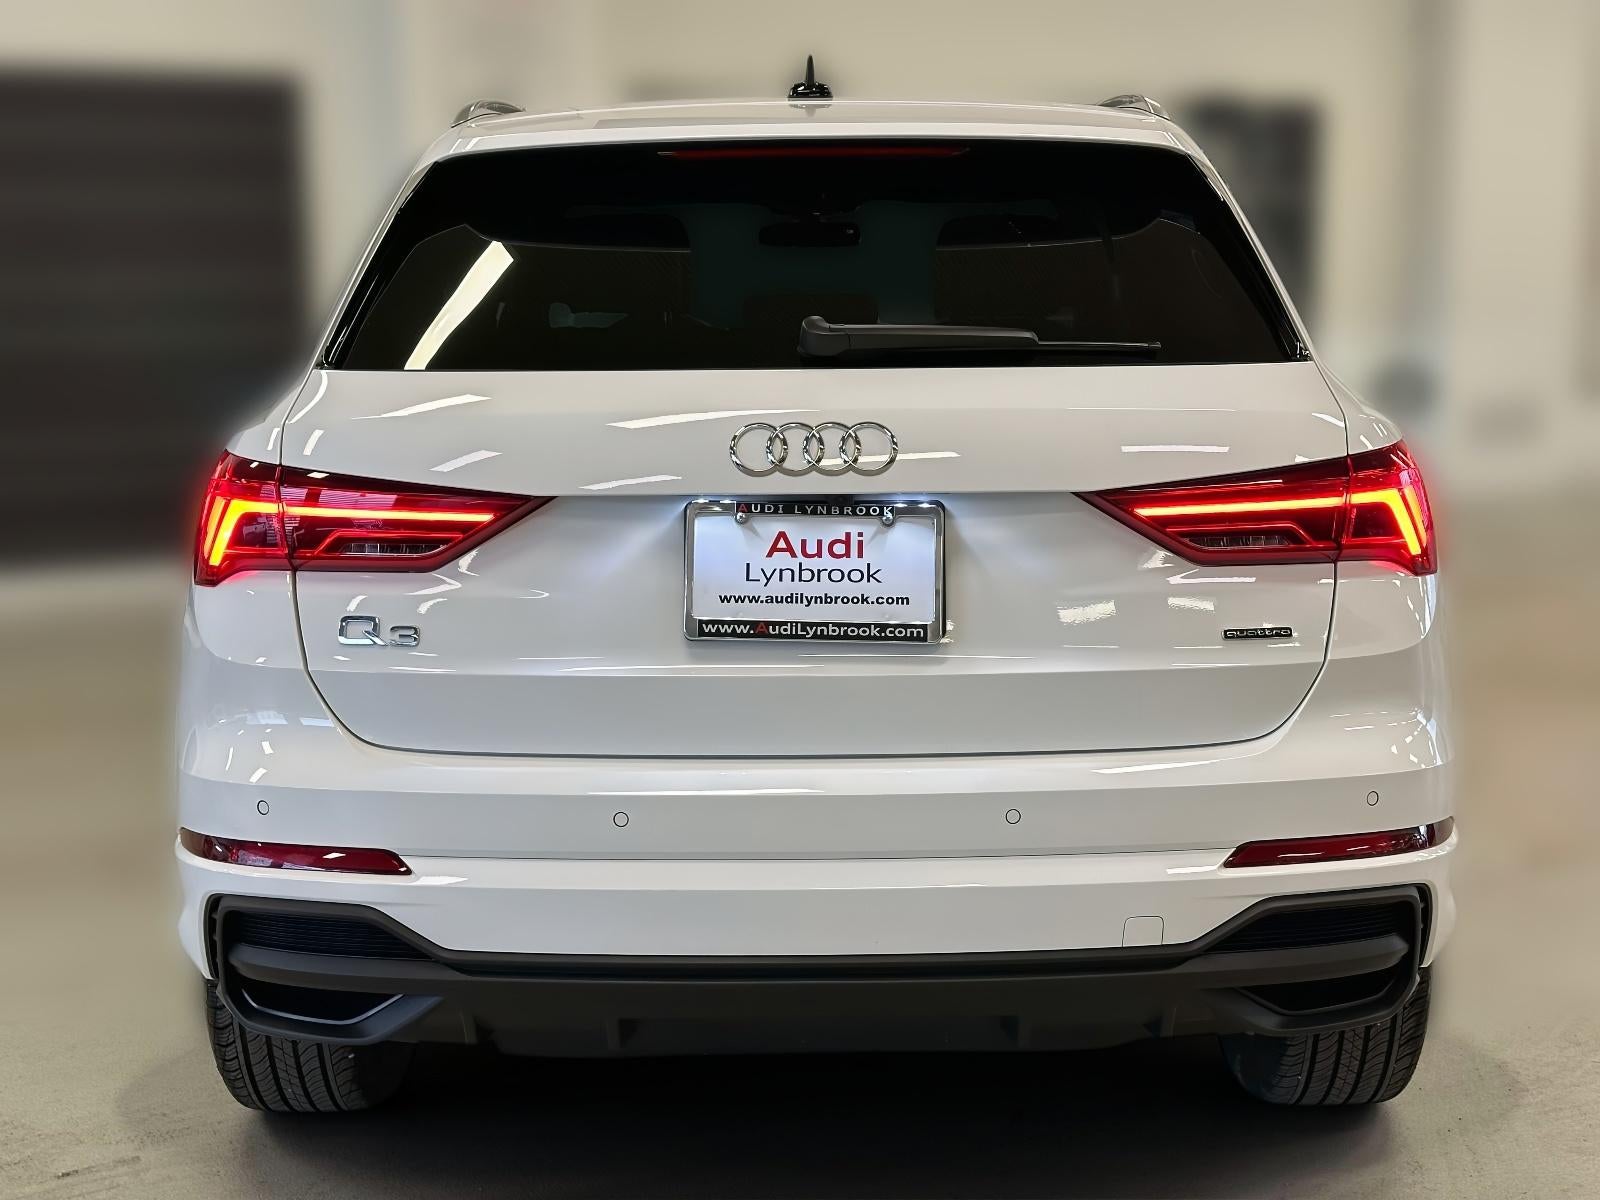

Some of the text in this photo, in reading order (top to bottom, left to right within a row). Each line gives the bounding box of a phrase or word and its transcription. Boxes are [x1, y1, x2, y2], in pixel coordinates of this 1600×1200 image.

[738, 503, 893, 517] AUDI LYNBROOK
[765, 530, 865, 559] Audi
[745, 562, 882, 587] Lynbrook
[719, 592, 910, 608] www.audilynbrook.com
[338, 615, 420, 647] Q3
[702, 621, 924, 638] www.AudiLynbrook.com
[1226, 628, 1291, 637] quattro
